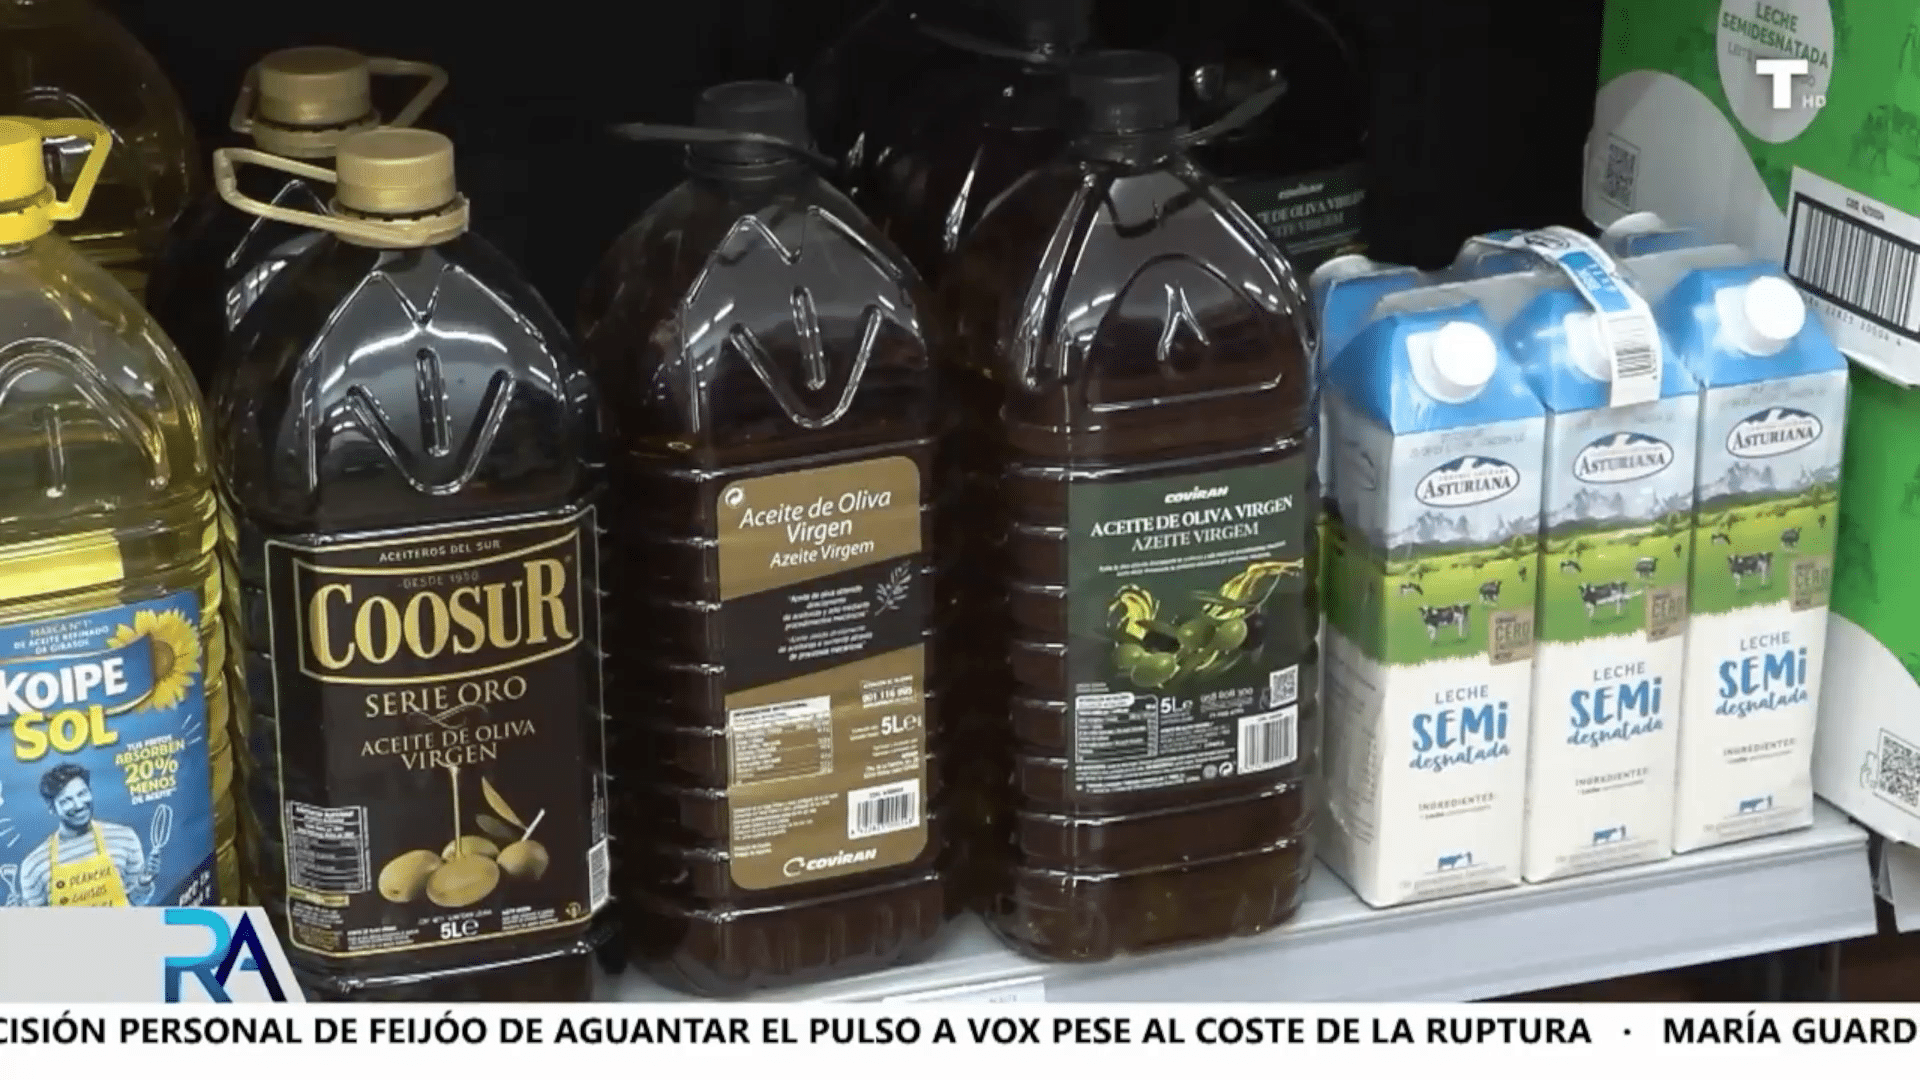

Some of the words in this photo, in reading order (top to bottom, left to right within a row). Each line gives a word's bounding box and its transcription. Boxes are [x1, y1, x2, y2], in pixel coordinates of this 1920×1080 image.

[1756, 2, 1798, 33] LECHE
[1722, 12, 1829, 69] SEMIDESNATADA
[1733, 424, 1814, 450] ASTURIANA
[1580, 449, 1665, 476] ASTURIANA
[1423, 473, 1511, 500] ASTURIANA
[739, 503, 805, 529] Aceite
[808, 496, 834, 520] de
[838, 489, 892, 514] Oliva
[1090, 515, 1155, 538] ACEITE
[1156, 513, 1180, 531] DE
[1182, 507, 1233, 528] OLIVA
[1235, 495, 1294, 521] VIRGEN
[787, 519, 853, 545] Virgen
[1132, 530, 1191, 552] AZEITE
[1193, 522, 1260, 545] VIRGEM
[379, 544, 446, 563] ACEITEROS
[450, 542, 473, 556] DEL
[476, 539, 502, 553] SUR
[770, 547, 818, 570] Azeite
[821, 540, 875, 562] Virgem
[309, 558, 574, 671] COOSUR
[1740, 631, 1791, 652] LECHE
[1593, 661, 1646, 682] LECHE
[0, 656, 129, 718] KOIPE
[365, 686, 449, 718] SERIE
[458, 675, 528, 710] ORO
[1435, 684, 1490, 705] LECHE
[1715, 688, 1808, 718] desnatada
[13, 705, 119, 762] SOL
[360, 731, 435, 758] ACEITE
[441, 727, 471, 748] DE
[475, 717, 537, 742] OLIVA
[1566, 716, 1664, 748] desnatada
[115, 738, 186, 766] ABSORBEN
[400, 741, 498, 771] VIRGEN
[1409, 741, 1511, 773] desnatada
[125, 755, 179, 786] 20%
[130, 774, 176, 796] MENOS
